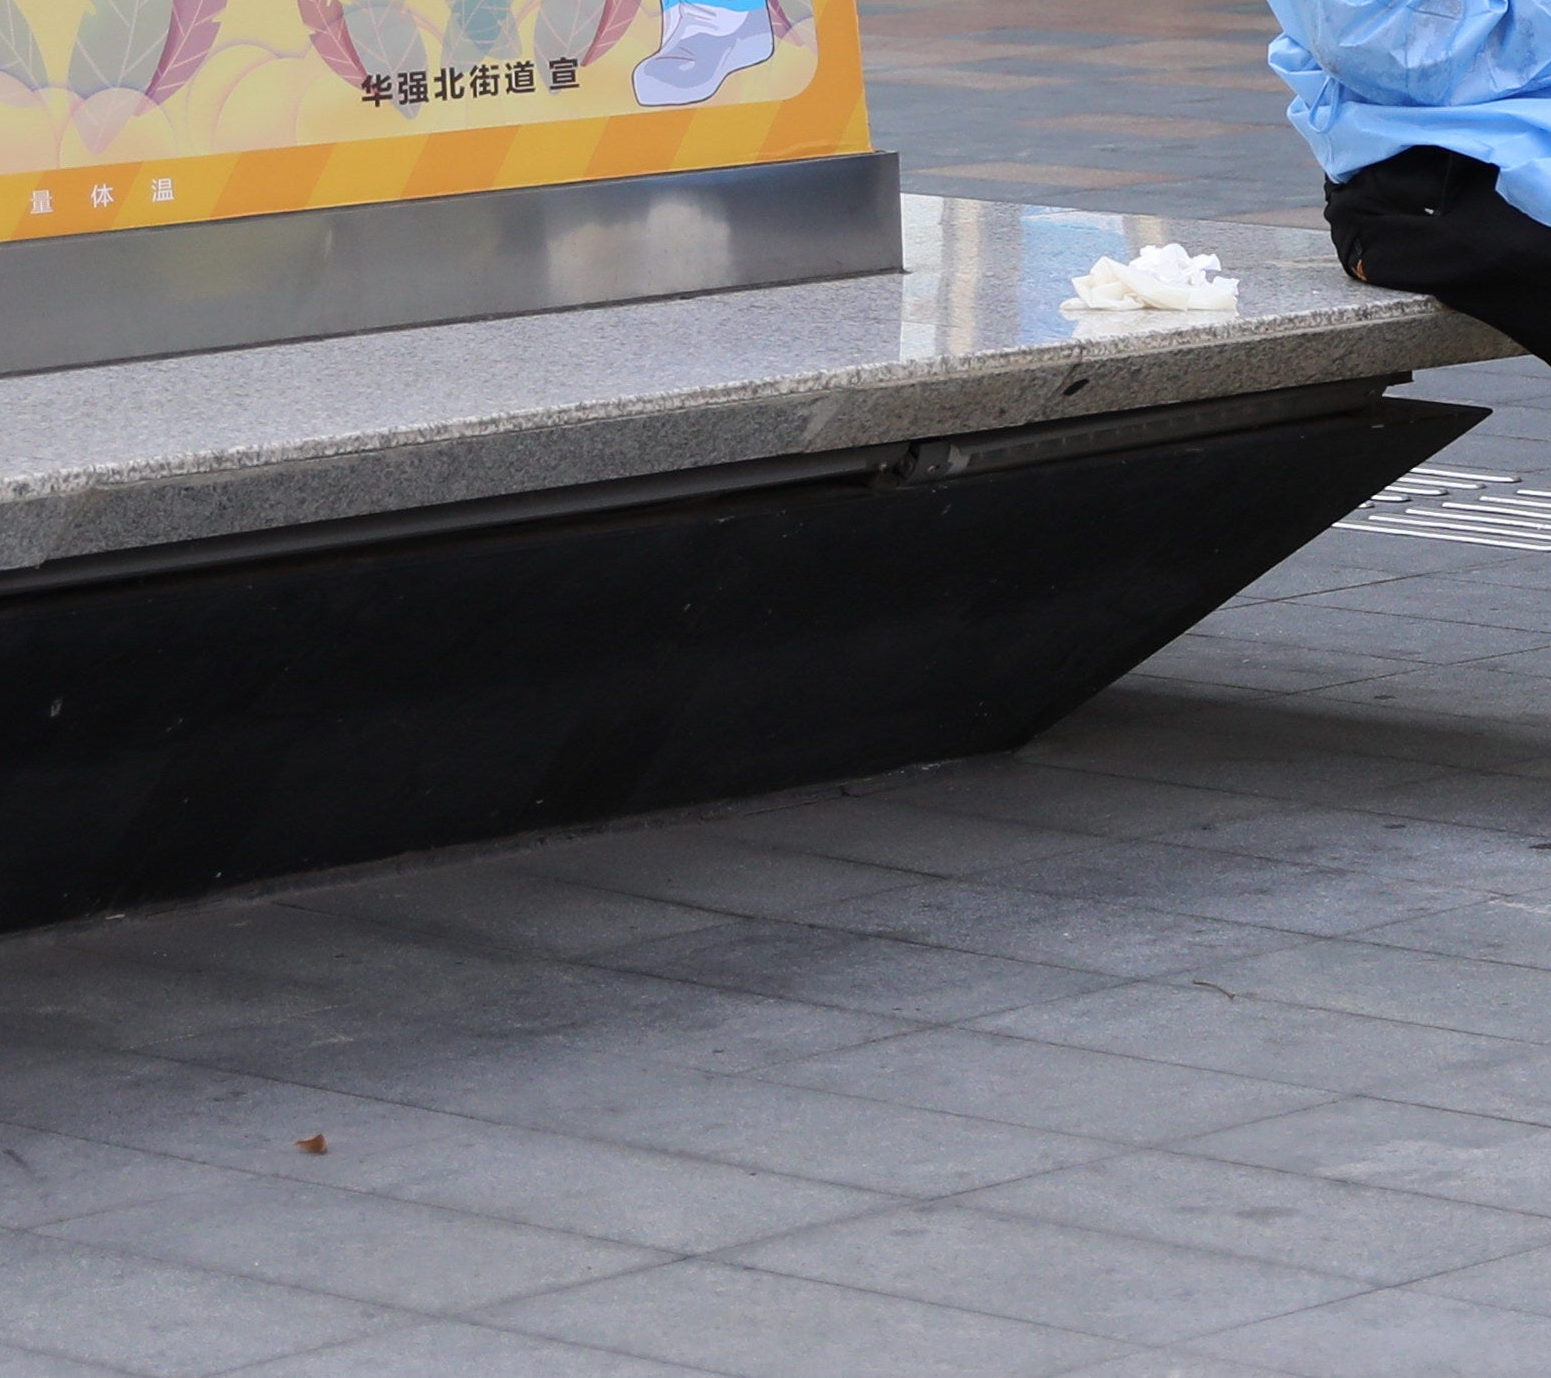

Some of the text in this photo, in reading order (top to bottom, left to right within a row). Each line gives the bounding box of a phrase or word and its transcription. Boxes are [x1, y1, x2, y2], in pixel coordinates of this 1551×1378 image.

[360, 56, 581, 108] 华强北街道 宣
